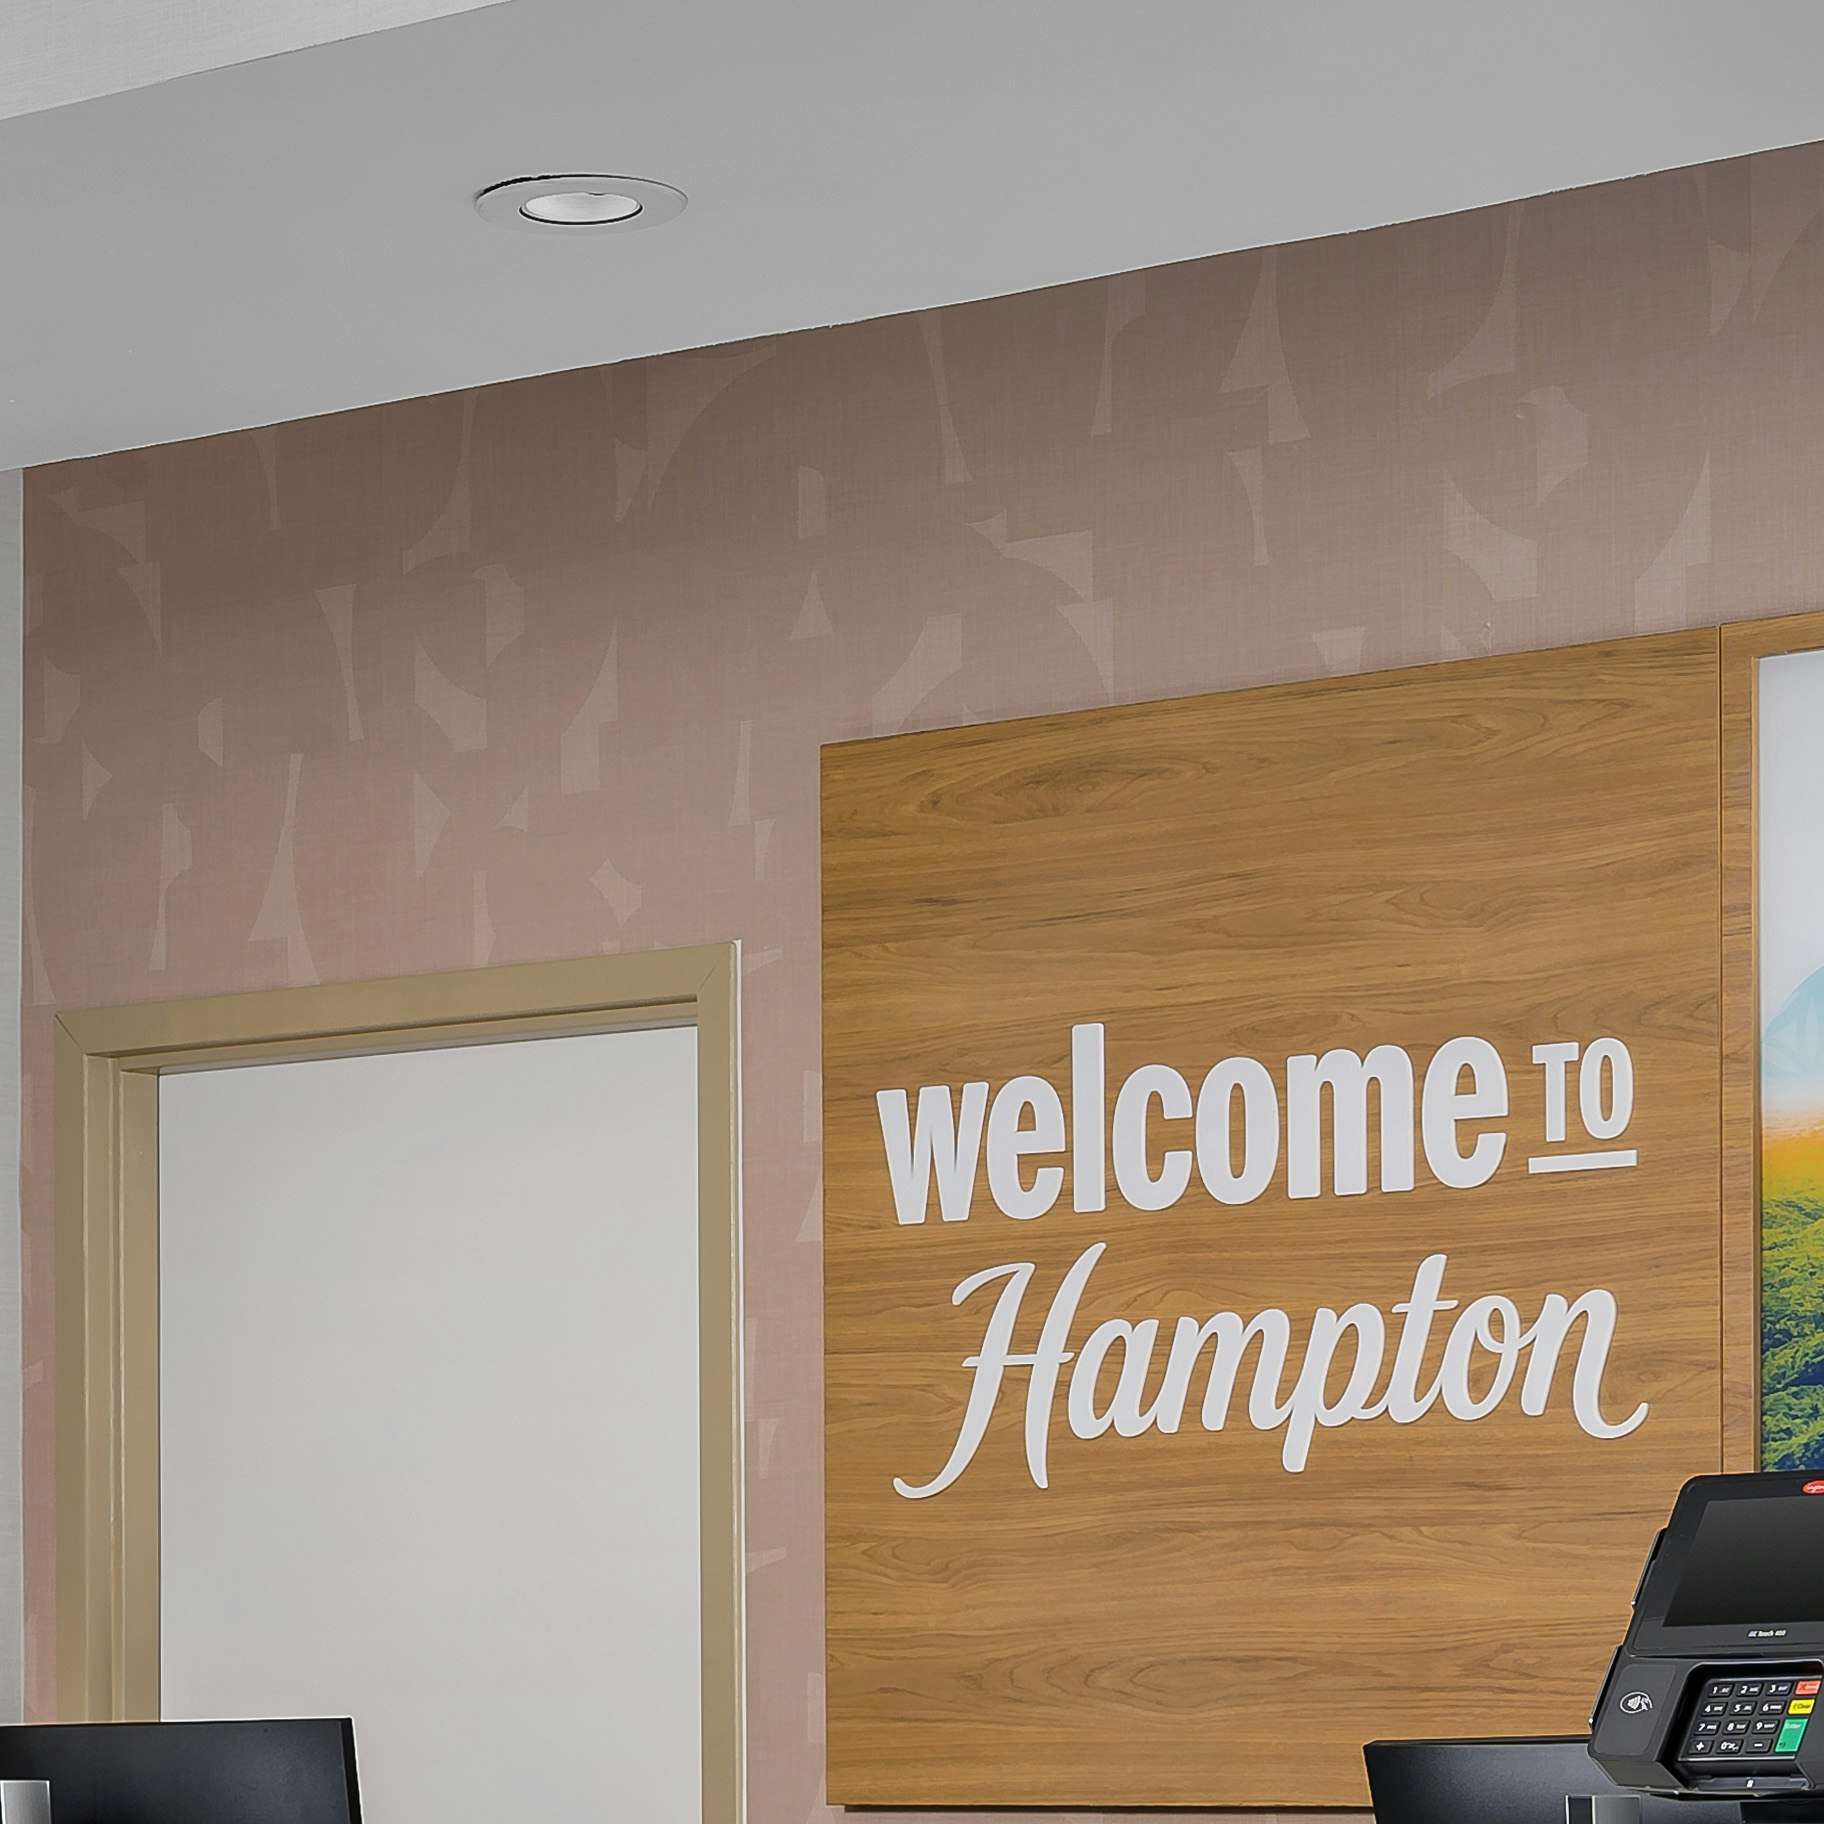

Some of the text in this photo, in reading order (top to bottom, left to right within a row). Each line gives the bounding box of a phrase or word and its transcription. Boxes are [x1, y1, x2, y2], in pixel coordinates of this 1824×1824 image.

[876, 1023, 1635, 1225] welcome TO
[893, 1242, 1650, 1499] Hampton
